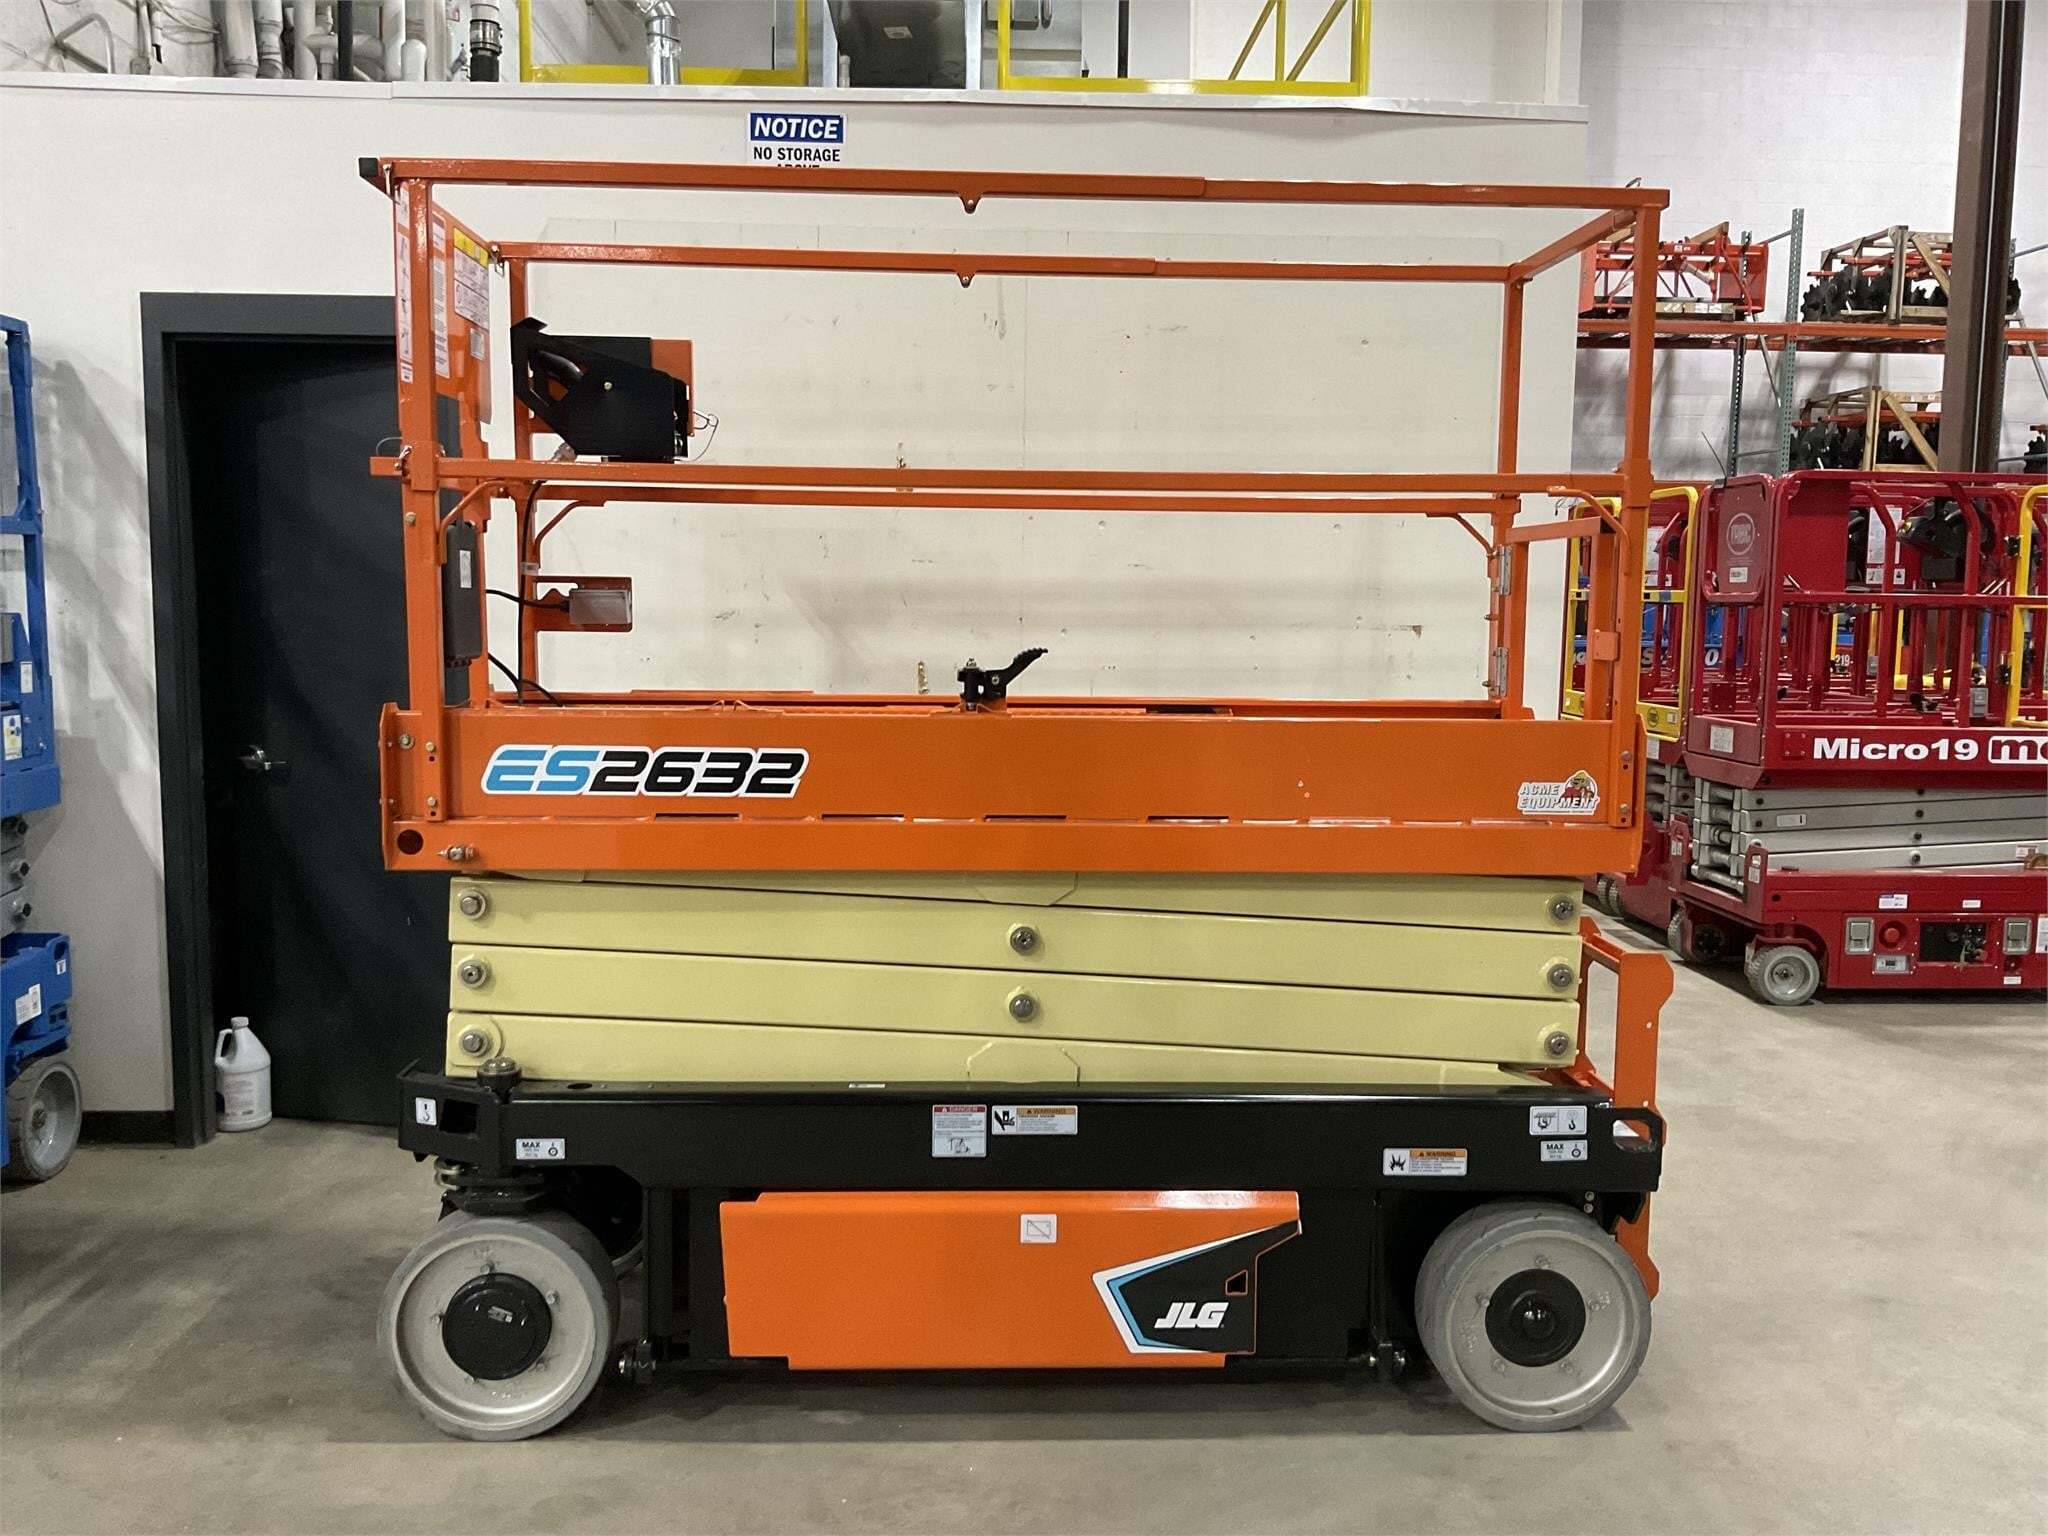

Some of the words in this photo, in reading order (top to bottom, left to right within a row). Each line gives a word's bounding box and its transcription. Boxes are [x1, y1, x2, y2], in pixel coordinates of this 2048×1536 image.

[754, 117, 840, 139] NOTICE
[753, 146, 773, 160] NO
[777, 147, 841, 162] STORAGE
[1813, 737, 1979, 761] Micro19
[1990, 739, 2048, 761] m
[484, 746, 808, 796] ES2632
[1520, 784, 1560, 796] ACME
[1519, 796, 1597, 810] EQUIPMENT
[1154, 1302, 1229, 1328] JLG
